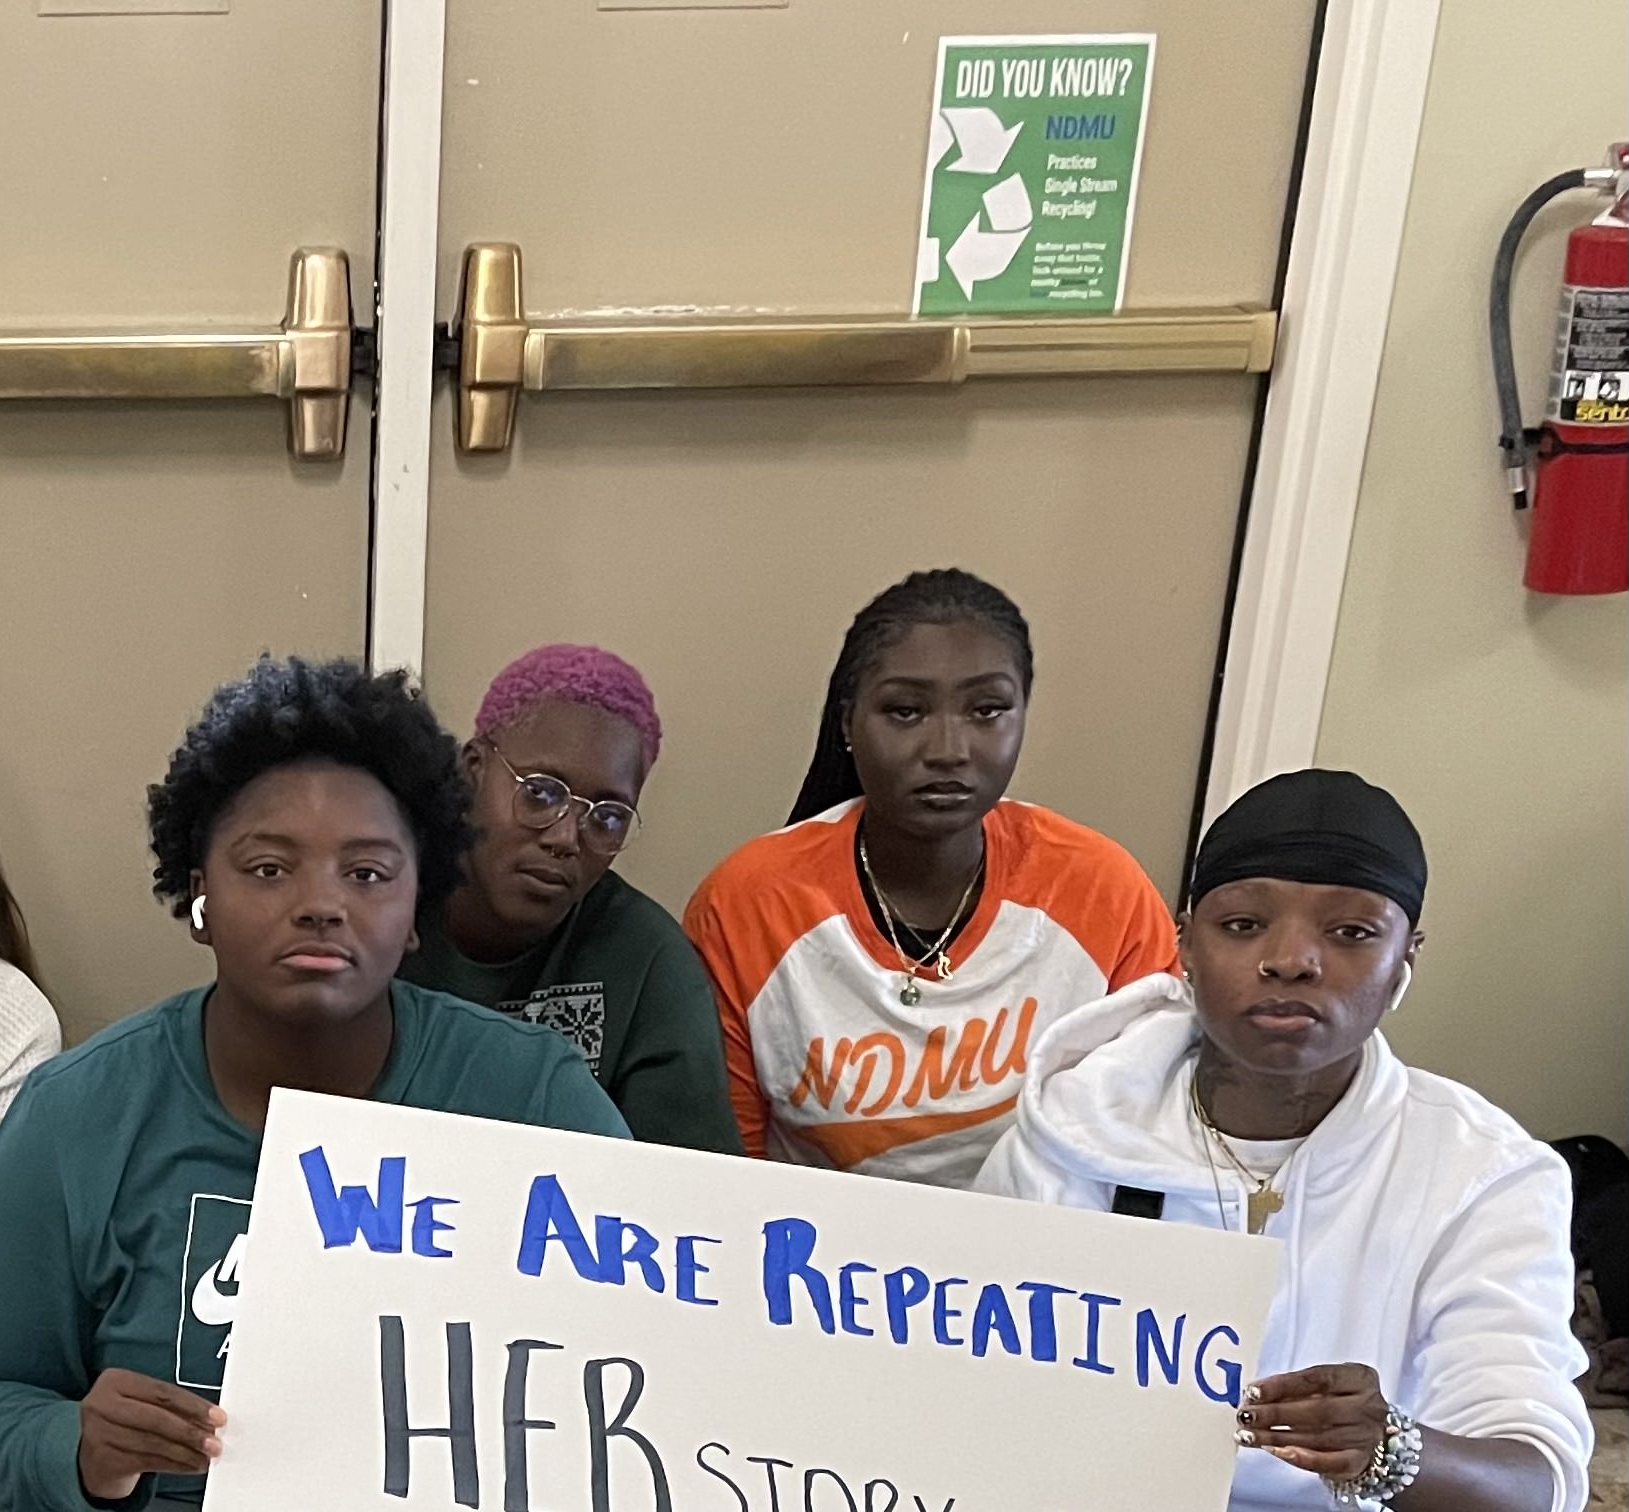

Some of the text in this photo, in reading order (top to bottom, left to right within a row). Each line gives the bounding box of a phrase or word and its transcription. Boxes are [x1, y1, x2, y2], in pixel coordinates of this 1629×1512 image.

[956, 57, 1133, 98] DID YOU KNOW?
[1045, 115, 1116, 140] NDMU
[1047, 154, 1097, 170] Practices
[1044, 176, 1117, 196] Single Stream
[789, 997, 1037, 1117] NDMU
[762, 1217, 1242, 1410] REPEATING
